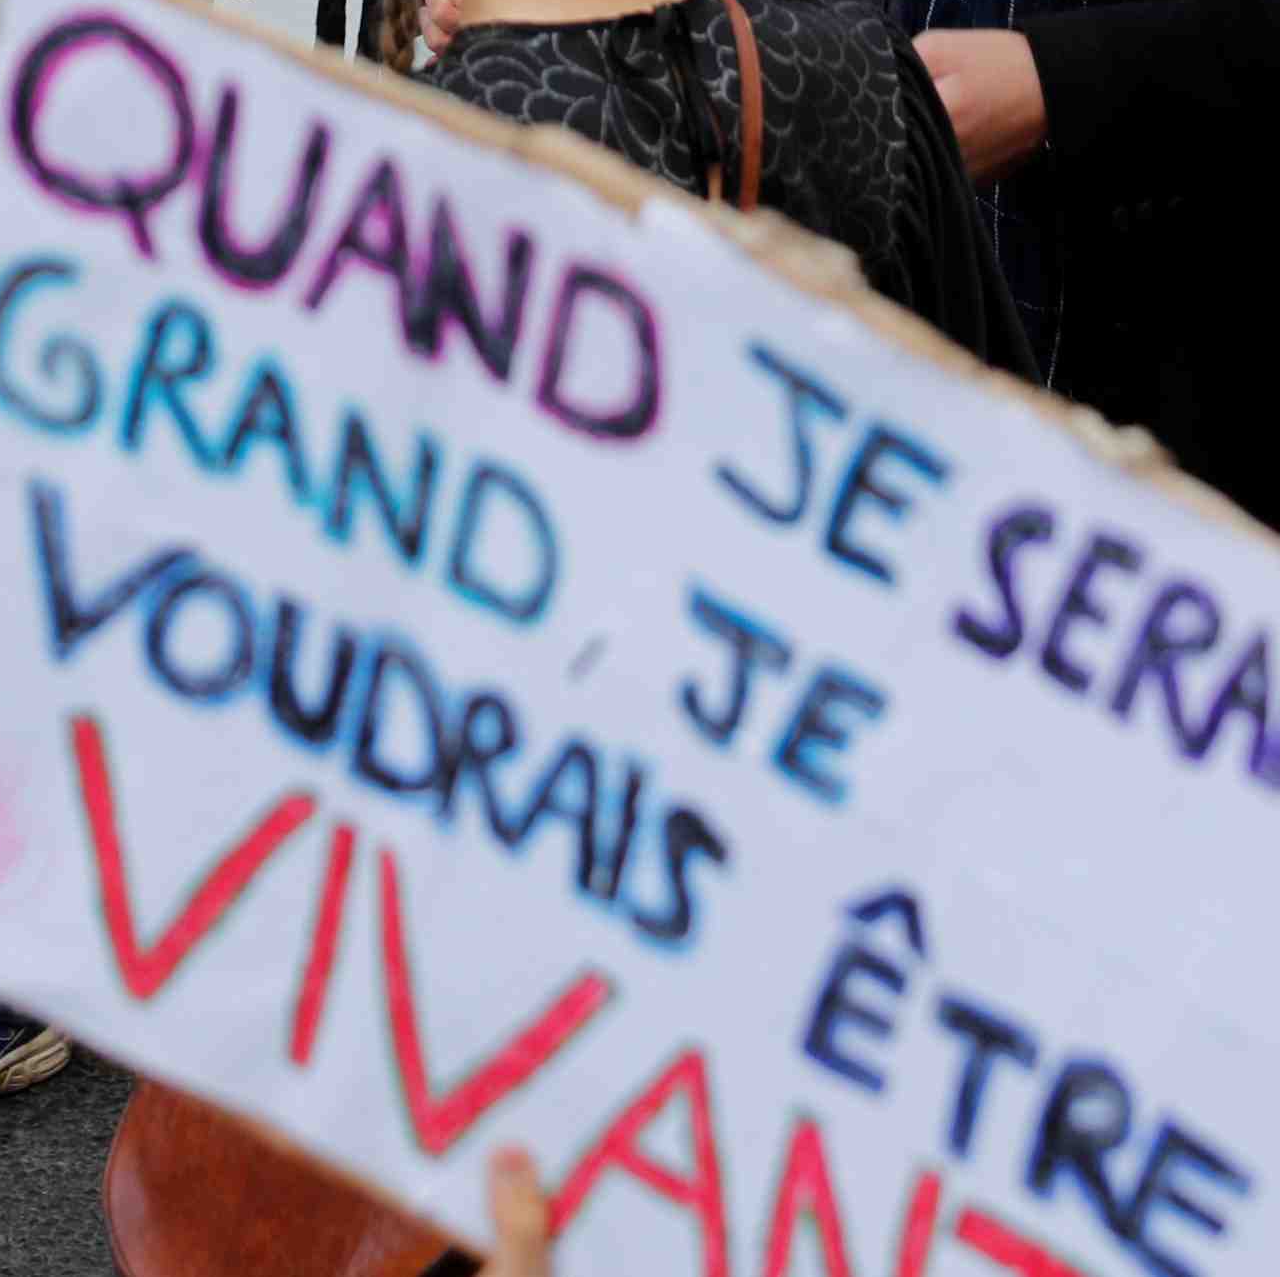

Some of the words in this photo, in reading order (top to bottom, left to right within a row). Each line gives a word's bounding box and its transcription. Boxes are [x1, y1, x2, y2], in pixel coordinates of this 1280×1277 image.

[10, 11, 666, 443] QUAND
[715, 337, 954, 589] JE
[26, 479, 732, 951] VOUDRAIS
[798, 888, 1256, 1277] ÊTRE
[679, 583, 890, 807] JE
